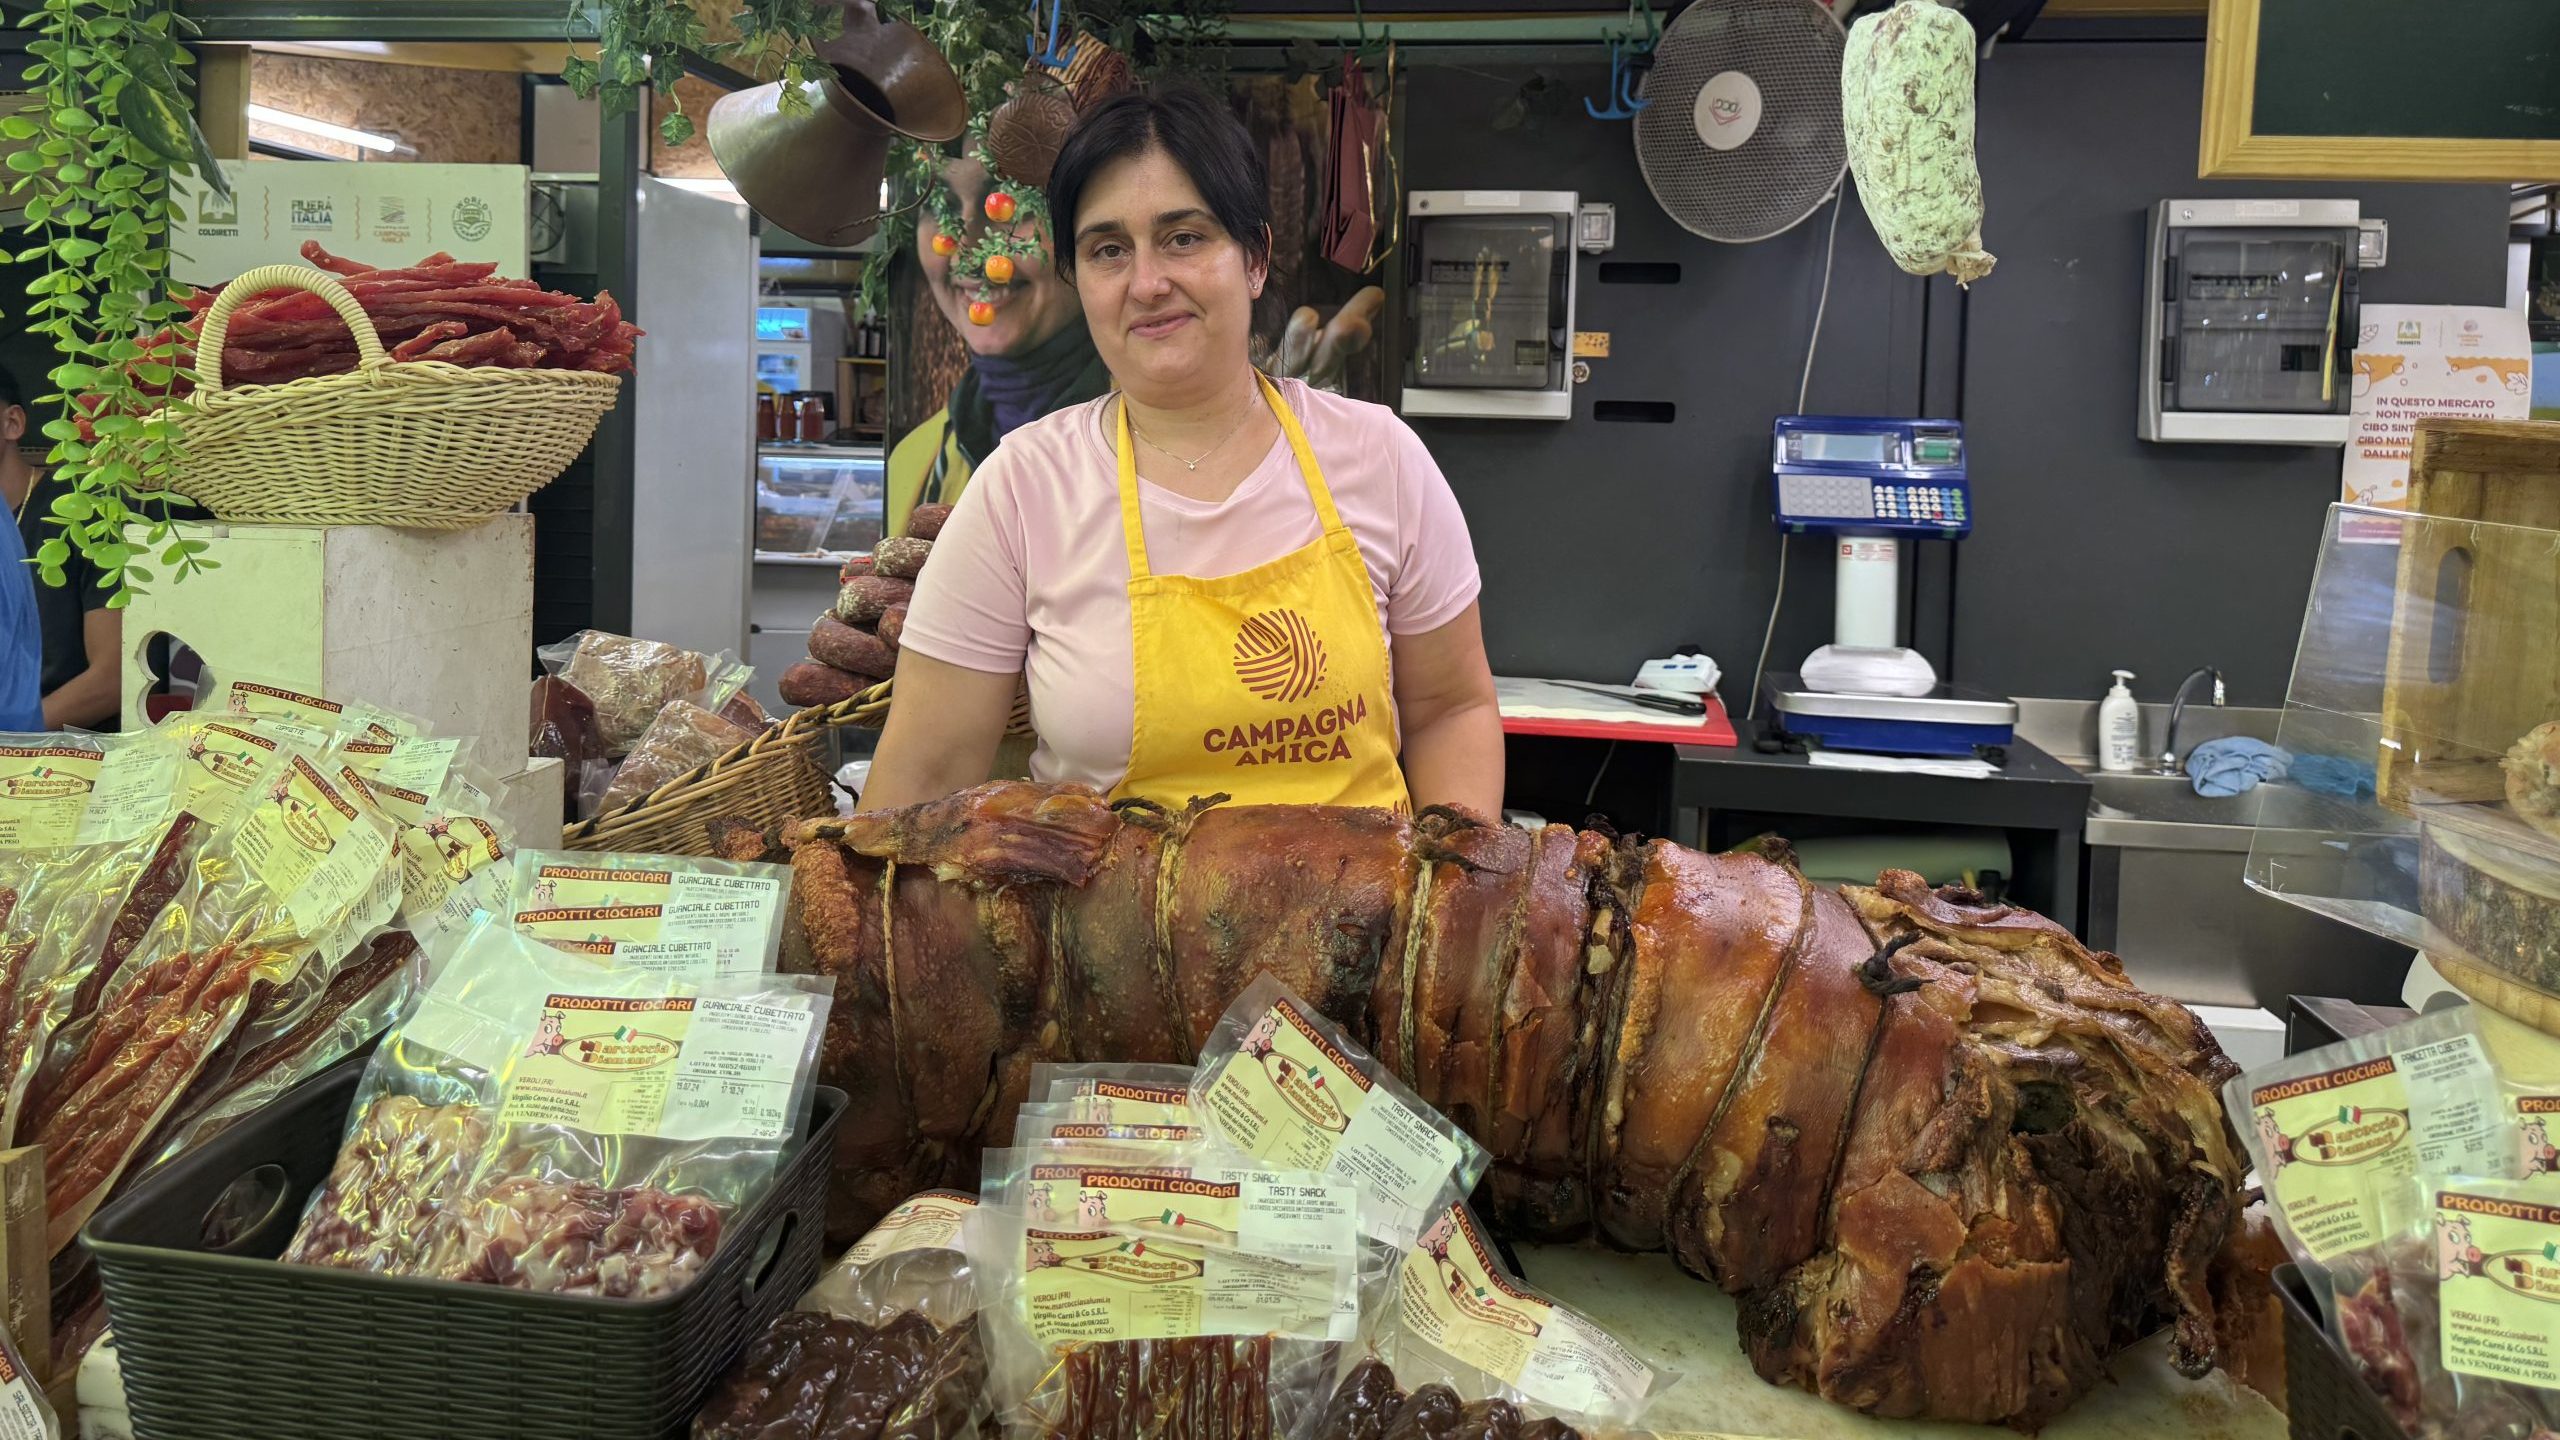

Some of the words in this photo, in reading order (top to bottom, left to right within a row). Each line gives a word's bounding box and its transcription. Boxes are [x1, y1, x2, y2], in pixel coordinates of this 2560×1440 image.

[291, 199, 333, 211] FILIERA
[456, 196, 490, 210] WORLD
[291, 211, 333, 225] ITALIA
[198, 228, 239, 237] COLDIRETTI
[2376, 397, 2388, 406] IN
[2391, 398, 2436, 407] QUESTO
[2438, 399, 2495, 408] MERCATO
[2376, 410, 2401, 419] NON
[2362, 423, 2389, 432] CIBO
[2391, 424, 2416, 433] SINT
[2358, 436, 2384, 445] CIBO
[2363, 449, 2398, 459] DALLE
[235, 682, 292, 700] PRODOTTI
[294, 695, 340, 713] CIOCIARI
[1203, 693, 1367, 752] CAMPAGNA
[207, 724, 252, 743] PRODOTTI
[44, 748, 102, 760] CIOCIARI
[345, 744, 391, 754] CIOCIARI
[1235, 735, 1352, 767] AMICA
[294, 756, 327, 793] PRODOTTI
[325, 788, 359, 820] CIOCIARI
[543, 867, 608, 882] PRODOTTI
[611, 870, 668, 883] CIOCIARI
[678, 875, 722, 887] GUANCIALE
[725, 878, 771, 891] CUBETTATO
[669, 902, 711, 914] GUANCIALE
[715, 899, 760, 911] CUBETTATO
[519, 909, 592, 924] PRODOTTI
[594, 906, 660, 919] CIOCIARI
[622, 943, 666, 954] GUANCIALE
[669, 940, 712, 952] CUBETTATO
[549, 997, 625, 1011] PRODOTTI
[629, 1000, 692, 1012] CIOCIARI
[702, 1000, 752, 1013] GUANCIALE
[753, 1005, 805, 1021] CUBETTATO
[1277, 1001, 1327, 1048] PRODOTTI
[1327, 1048, 1371, 1090] CIOCIARI
[2401, 1046, 2438, 1063] PANCETTA
[2254, 1076, 2330, 1105] PRODOTTI
[2333, 1059, 2394, 1086] CIOCIARI
[1098, 1084, 1167, 1103] PRODOTTI
[1390, 1102, 1414, 1123] TASTY
[1413, 1120, 1438, 1143] SNACK
[1055, 1126, 1130, 1138] PRODOTTI
[1220, 1171, 1249, 1182] TASTY
[1252, 1172, 1281, 1184] SNACK
[1086, 1175, 1165, 1191] PRODOTTI
[1170, 1181, 1236, 1197] CIOCIARI
[1269, 1186, 1296, 1197] TASTY
[1300, 1187, 1327, 1198] SNACK
[2442, 1194, 2543, 1221] PRODOTTI
[2549, 1209, 2560, 1224] C
[1455, 1205, 1493, 1274] PRODOTTI
[1033, 1293, 1057, 1302] VEROLI
[1056, 1291, 1071, 1301] (FR)
[1033, 1312, 1057, 1321] Virgilio
[1057, 1311, 1075, 1320] Carni
[1075, 1310, 1081, 1318] &
[1081, 1309, 1090, 1317] Co
[2451, 1309, 2482, 1324] VEROLI
[2483, 1313, 2500, 1327] (FR)
[1094, 1326, 1115, 1335] PESO
[2450, 1333, 2481, 1347] Virgilio
[2482, 1339, 2506, 1351] Carni
[2506, 1342, 2514, 1352] &
[2514, 1343, 2525, 1354] Co
[2526, 1345, 2548, 1357] S.R.L.
[2451, 1355, 2466, 1367] DA
[2467, 1357, 2521, 1377] VENDERSI
[2521, 1367, 2531, 1378] A
[2531, 1368, 2557, 1382] PESO
